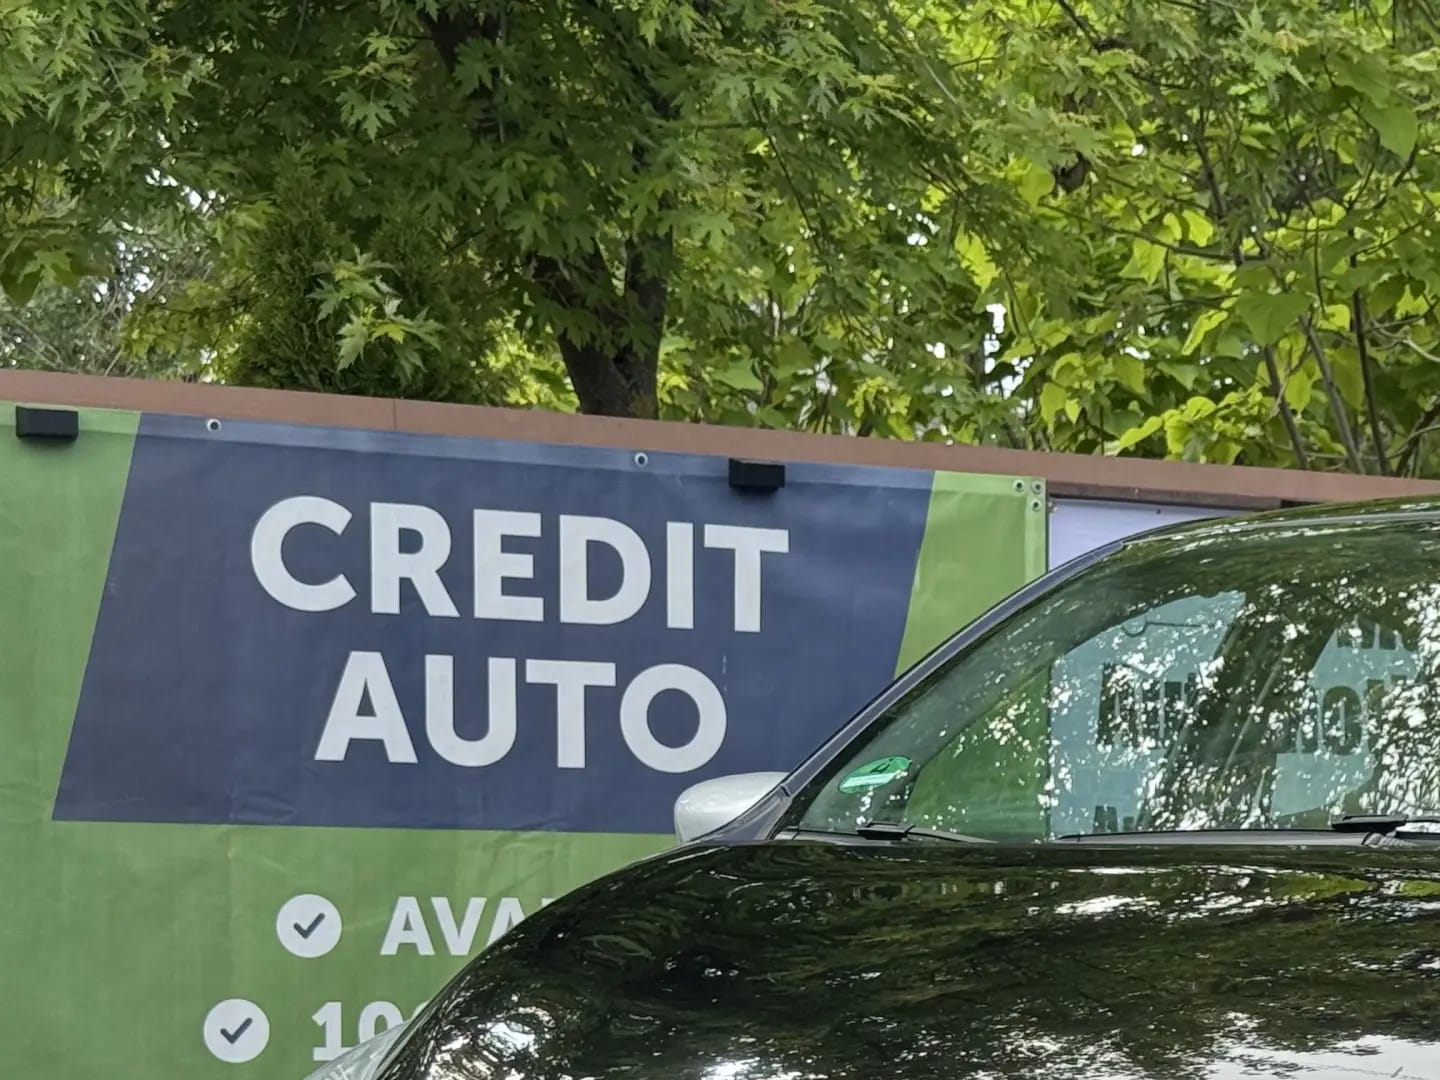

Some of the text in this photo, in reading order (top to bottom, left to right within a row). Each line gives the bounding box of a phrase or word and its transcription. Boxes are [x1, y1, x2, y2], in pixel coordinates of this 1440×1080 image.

[251, 496, 789, 632] CREDIT
[315, 651, 726, 772] AUTO
[380, 896, 553, 956] AVA
